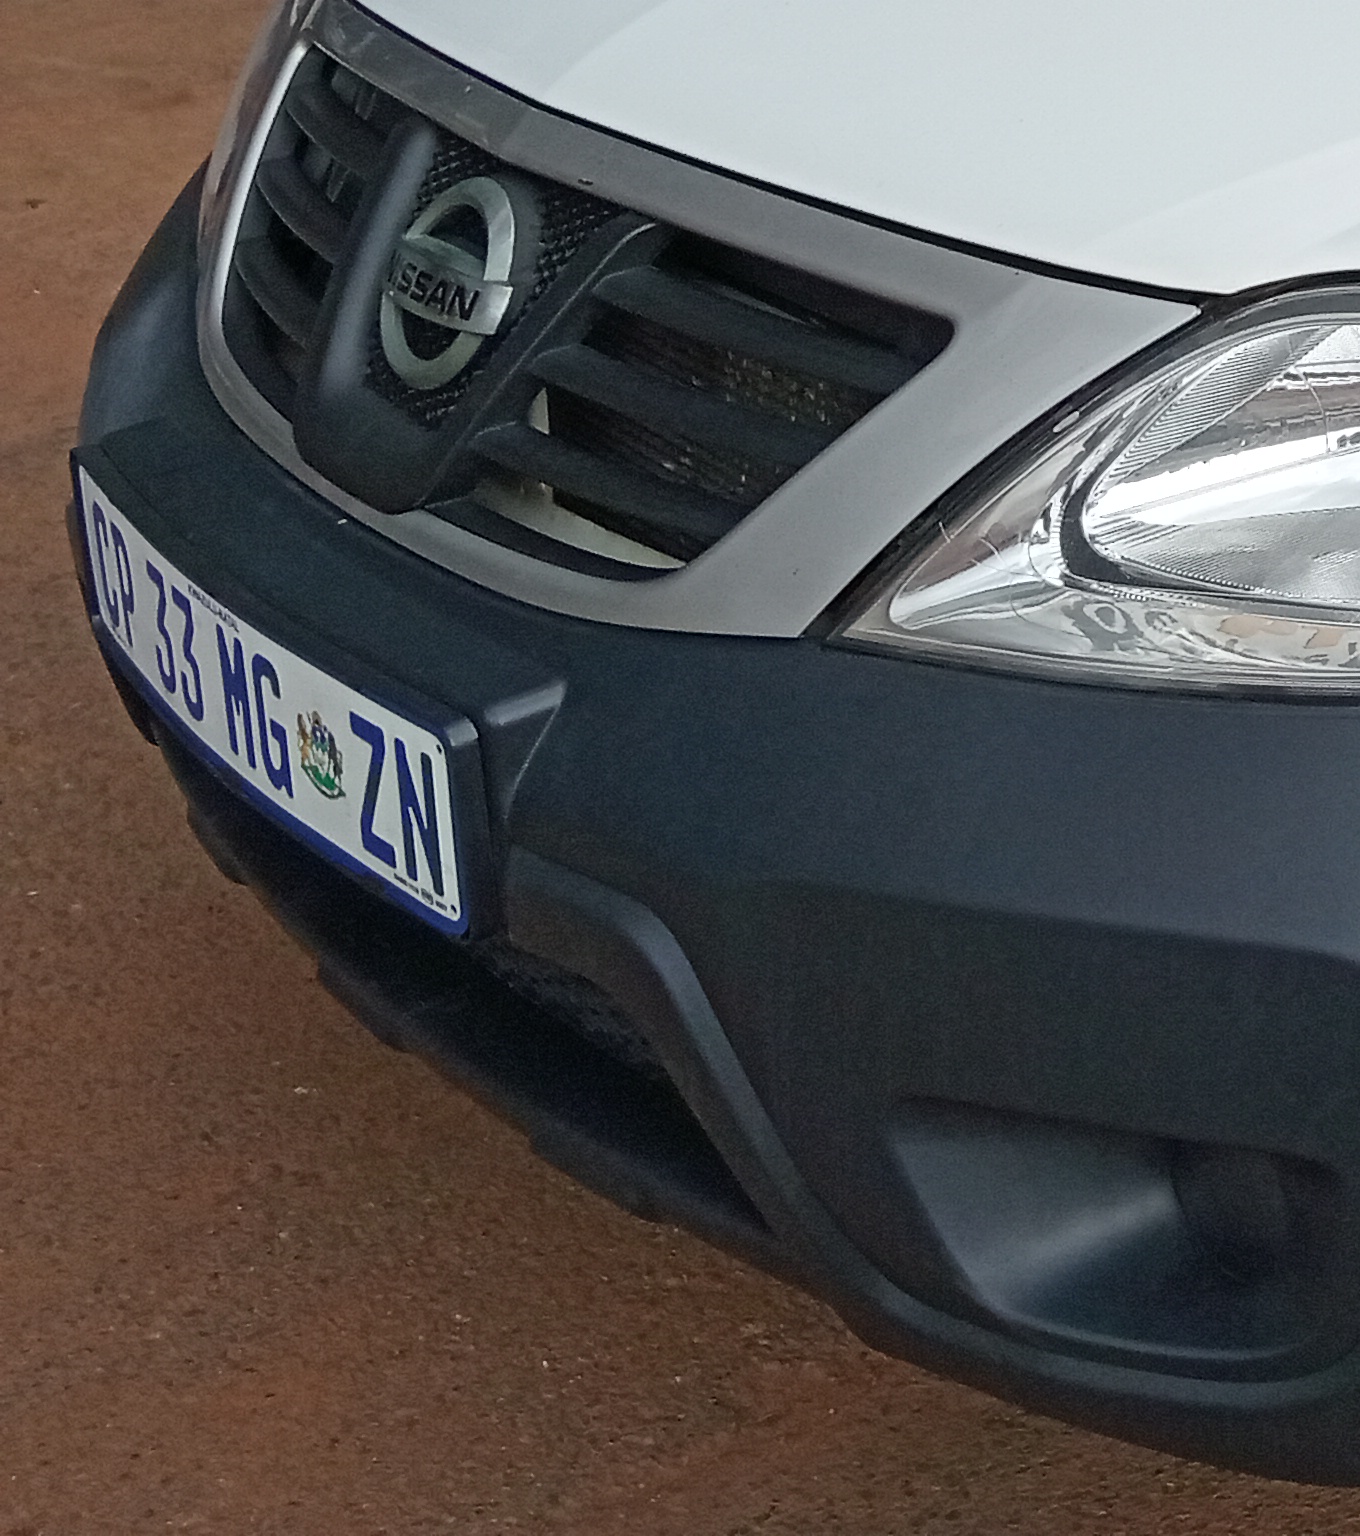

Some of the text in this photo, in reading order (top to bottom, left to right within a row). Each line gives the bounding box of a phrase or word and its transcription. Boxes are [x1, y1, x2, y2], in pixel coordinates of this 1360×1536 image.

[93, 500, 445, 897] CP 33 MG ZN
